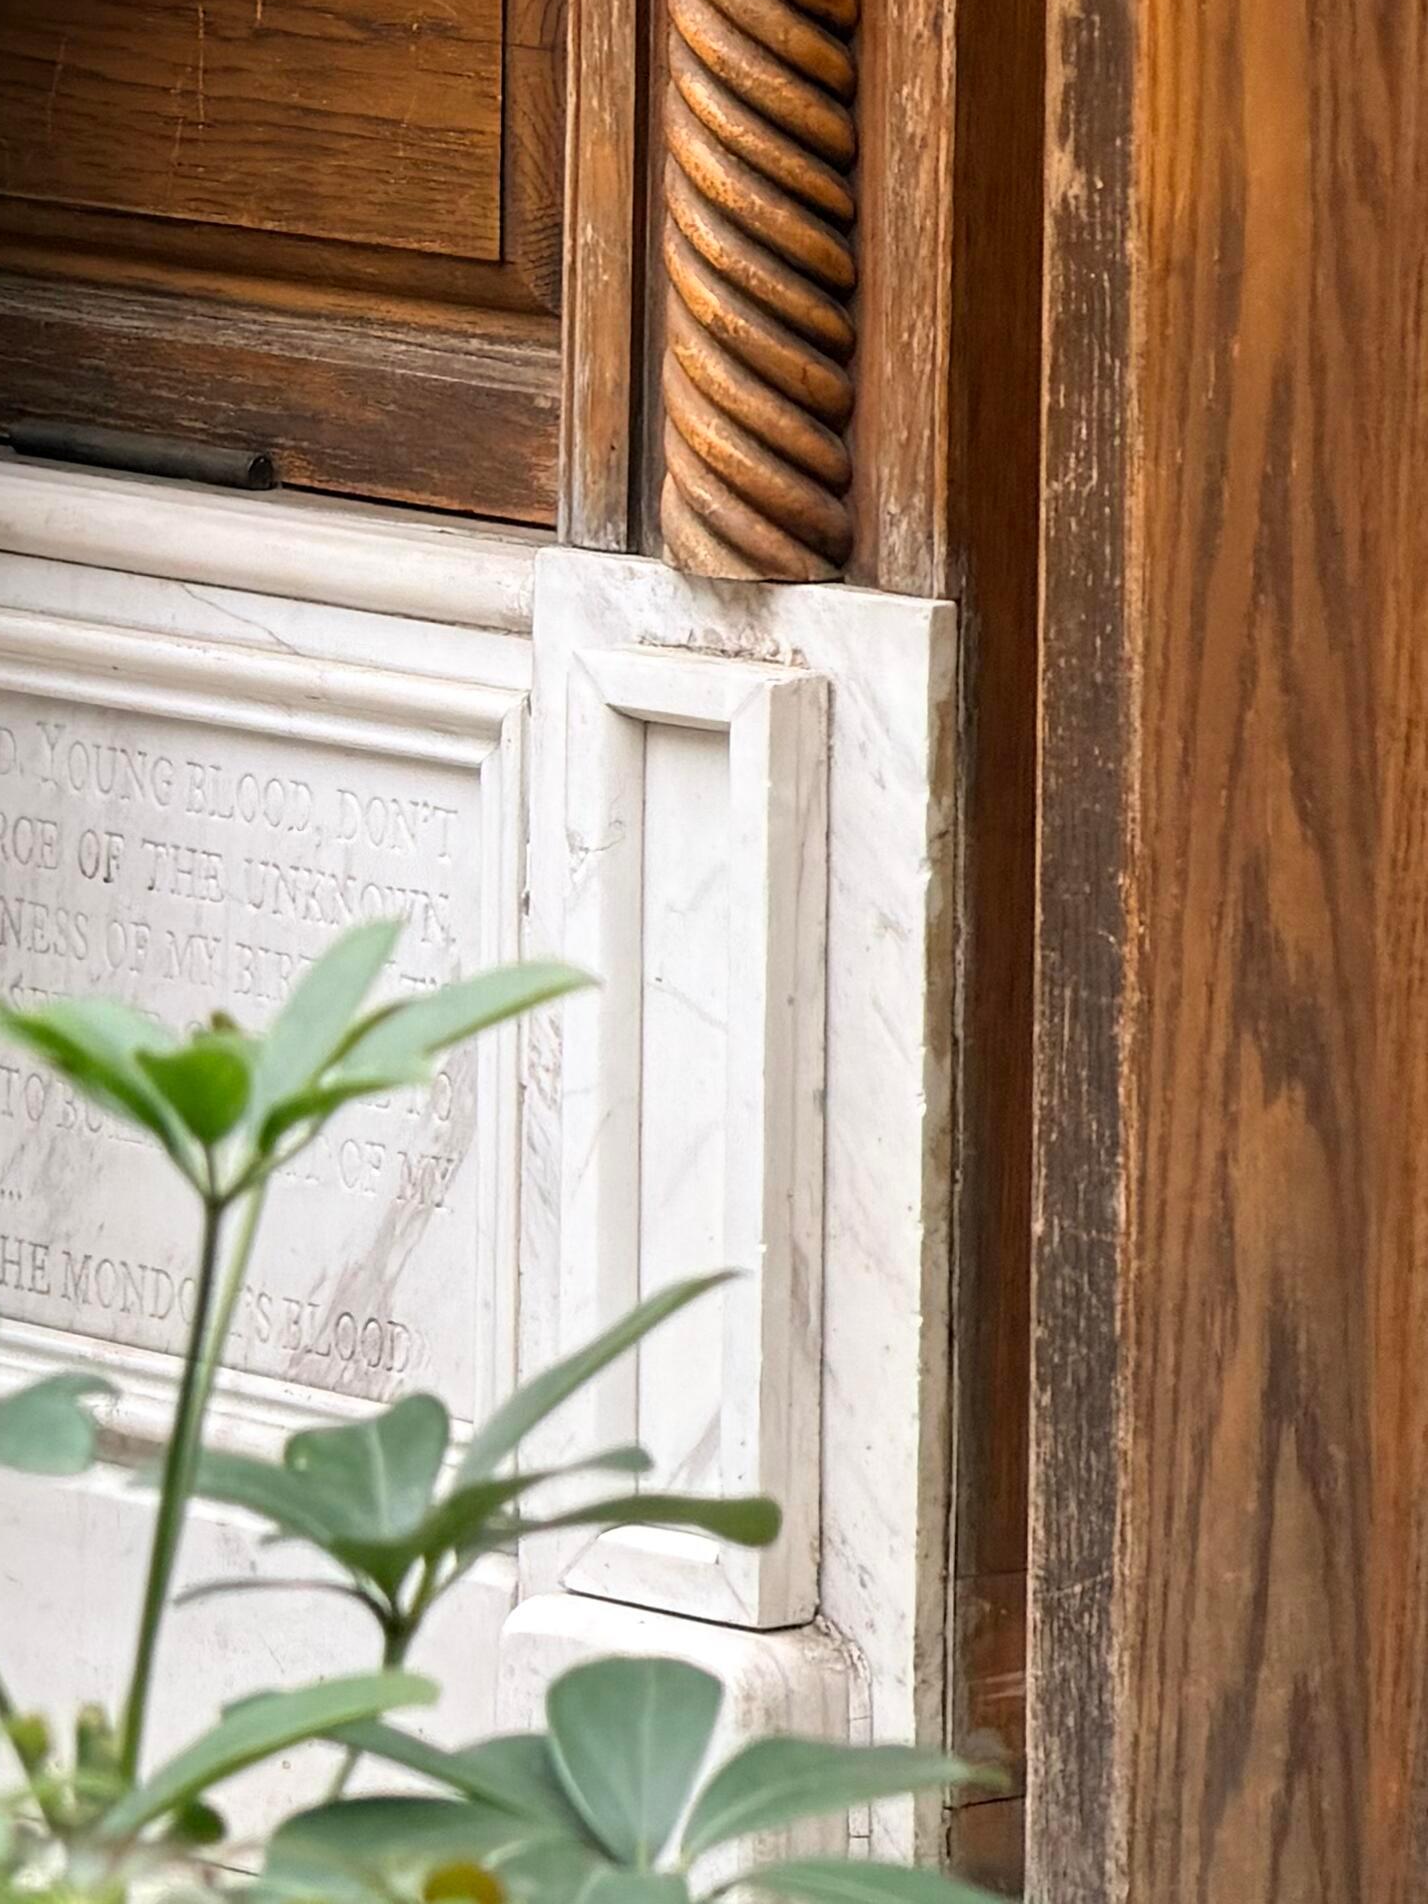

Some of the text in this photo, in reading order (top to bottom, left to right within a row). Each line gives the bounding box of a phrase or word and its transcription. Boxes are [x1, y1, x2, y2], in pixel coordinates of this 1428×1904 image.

[36, 720, 175, 807] YOUNG
[185, 760, 322, 850] BLOOD,
[336, 788, 459, 868] DON'T
[76, 828, 126, 884] OF
[140, 837, 225, 904] THE
[106, 920, 152, 974] OF
[163, 929, 223, 987] MY
